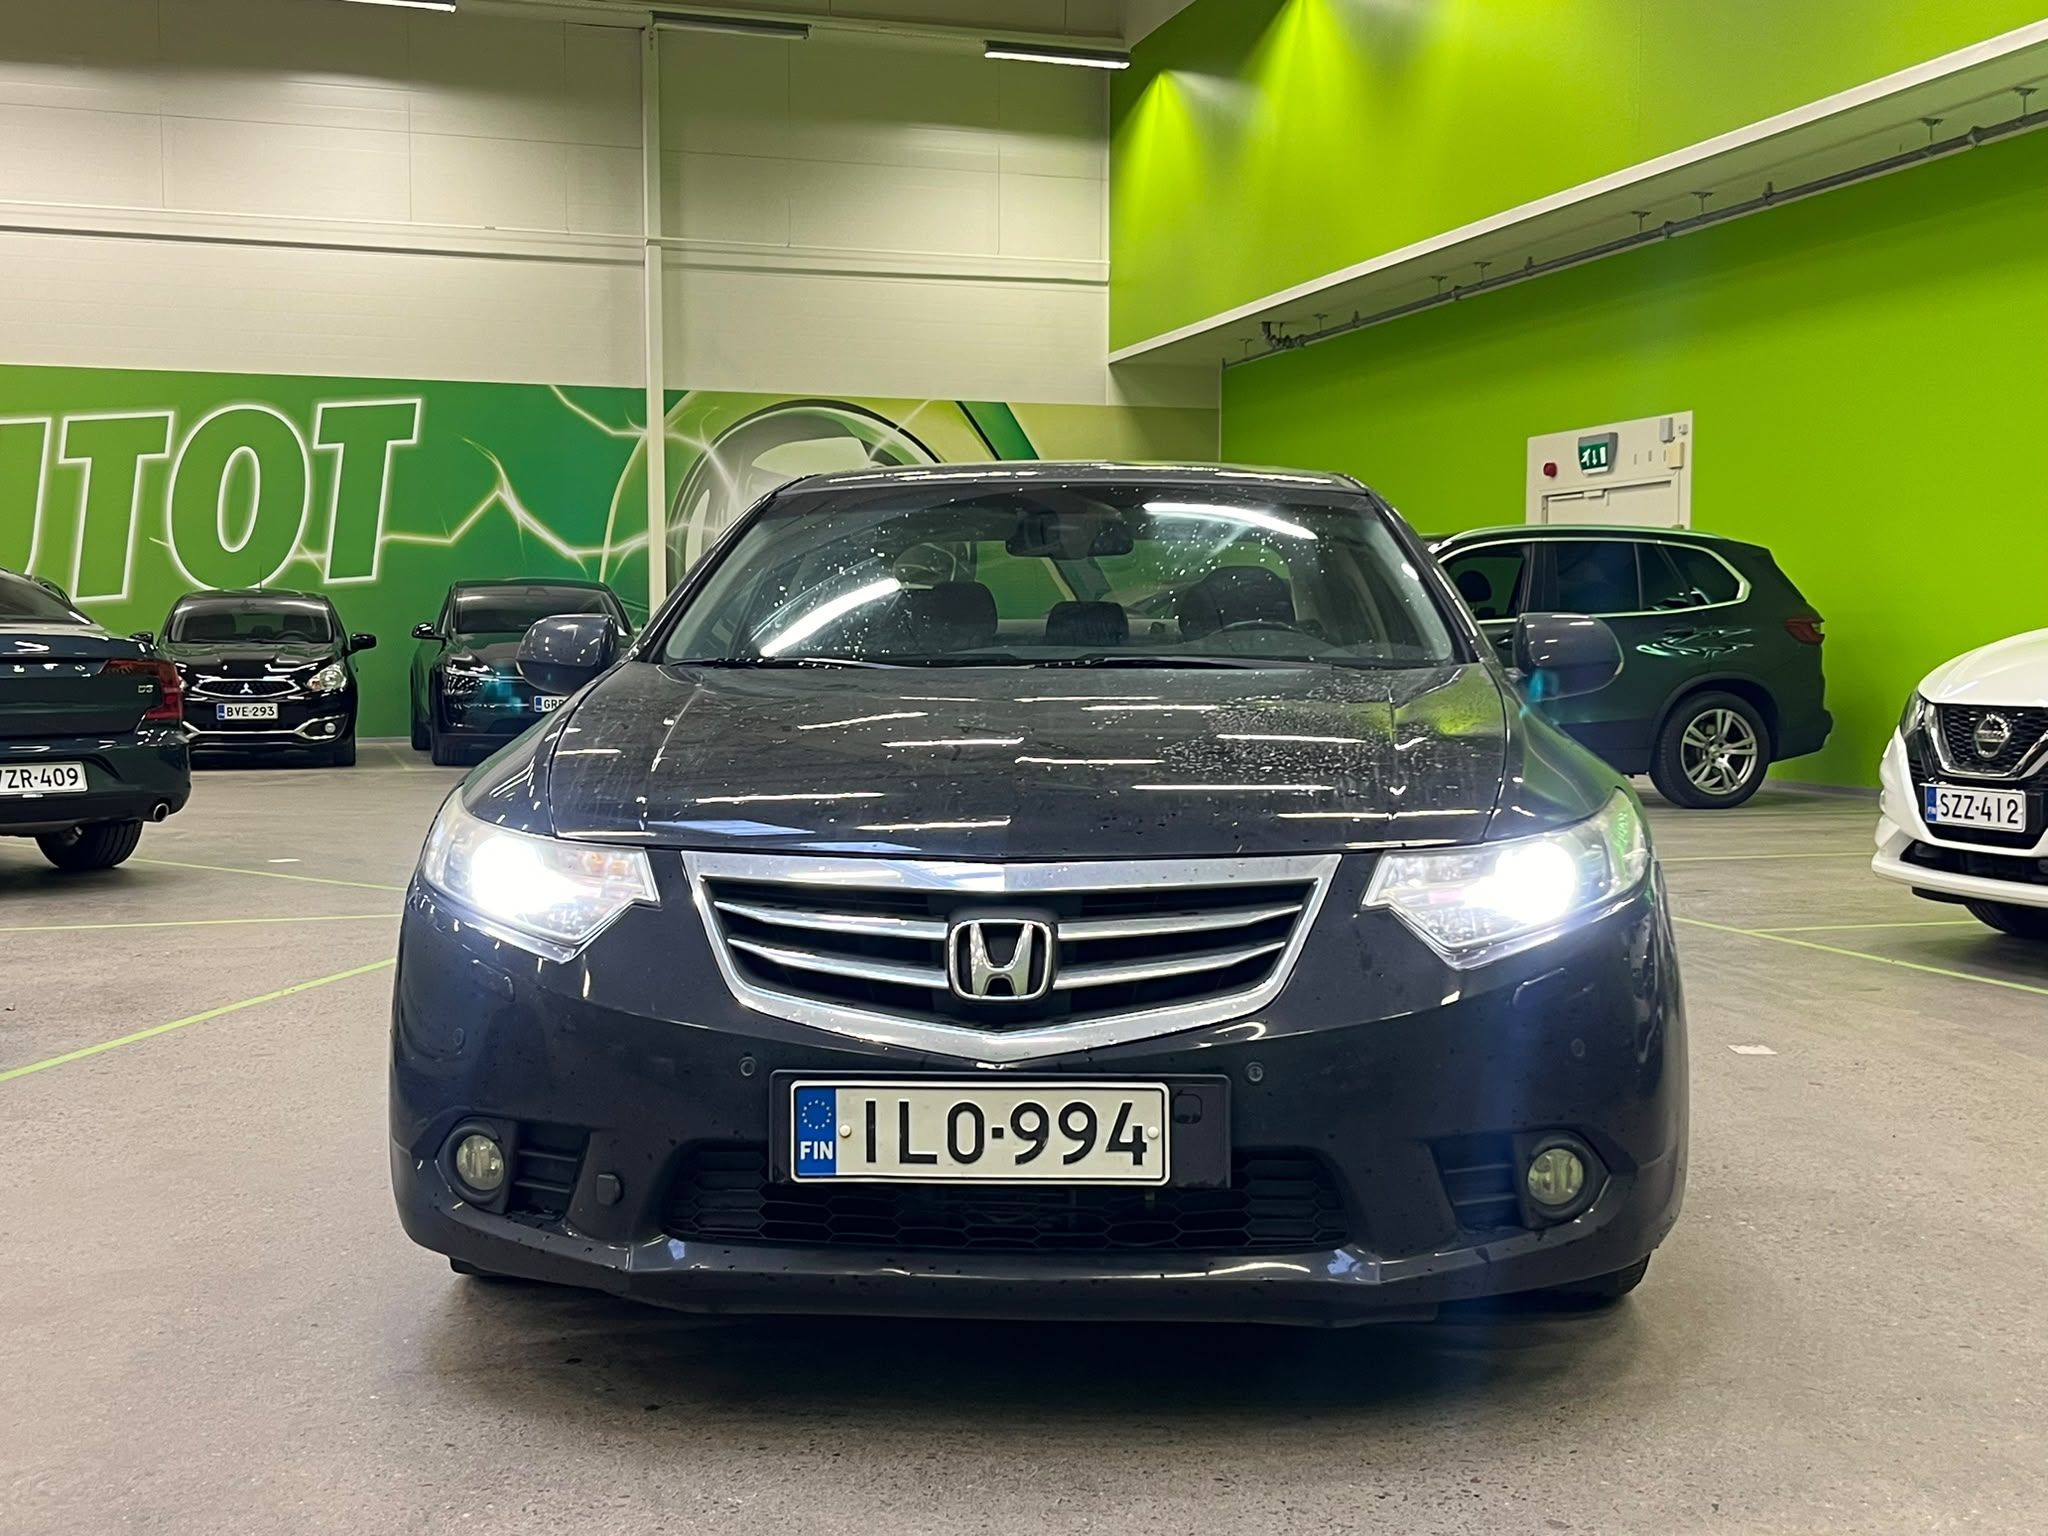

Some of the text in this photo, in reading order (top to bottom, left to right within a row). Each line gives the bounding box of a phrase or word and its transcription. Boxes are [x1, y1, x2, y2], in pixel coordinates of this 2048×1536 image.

[226, 706, 275, 717] BVE-293
[0, 767, 79, 790] ZR-409
[1940, 793, 2019, 824] SZZ-412
[865, 1100, 1147, 1166] ILO-994
[799, 1141, 834, 1160] FIN
